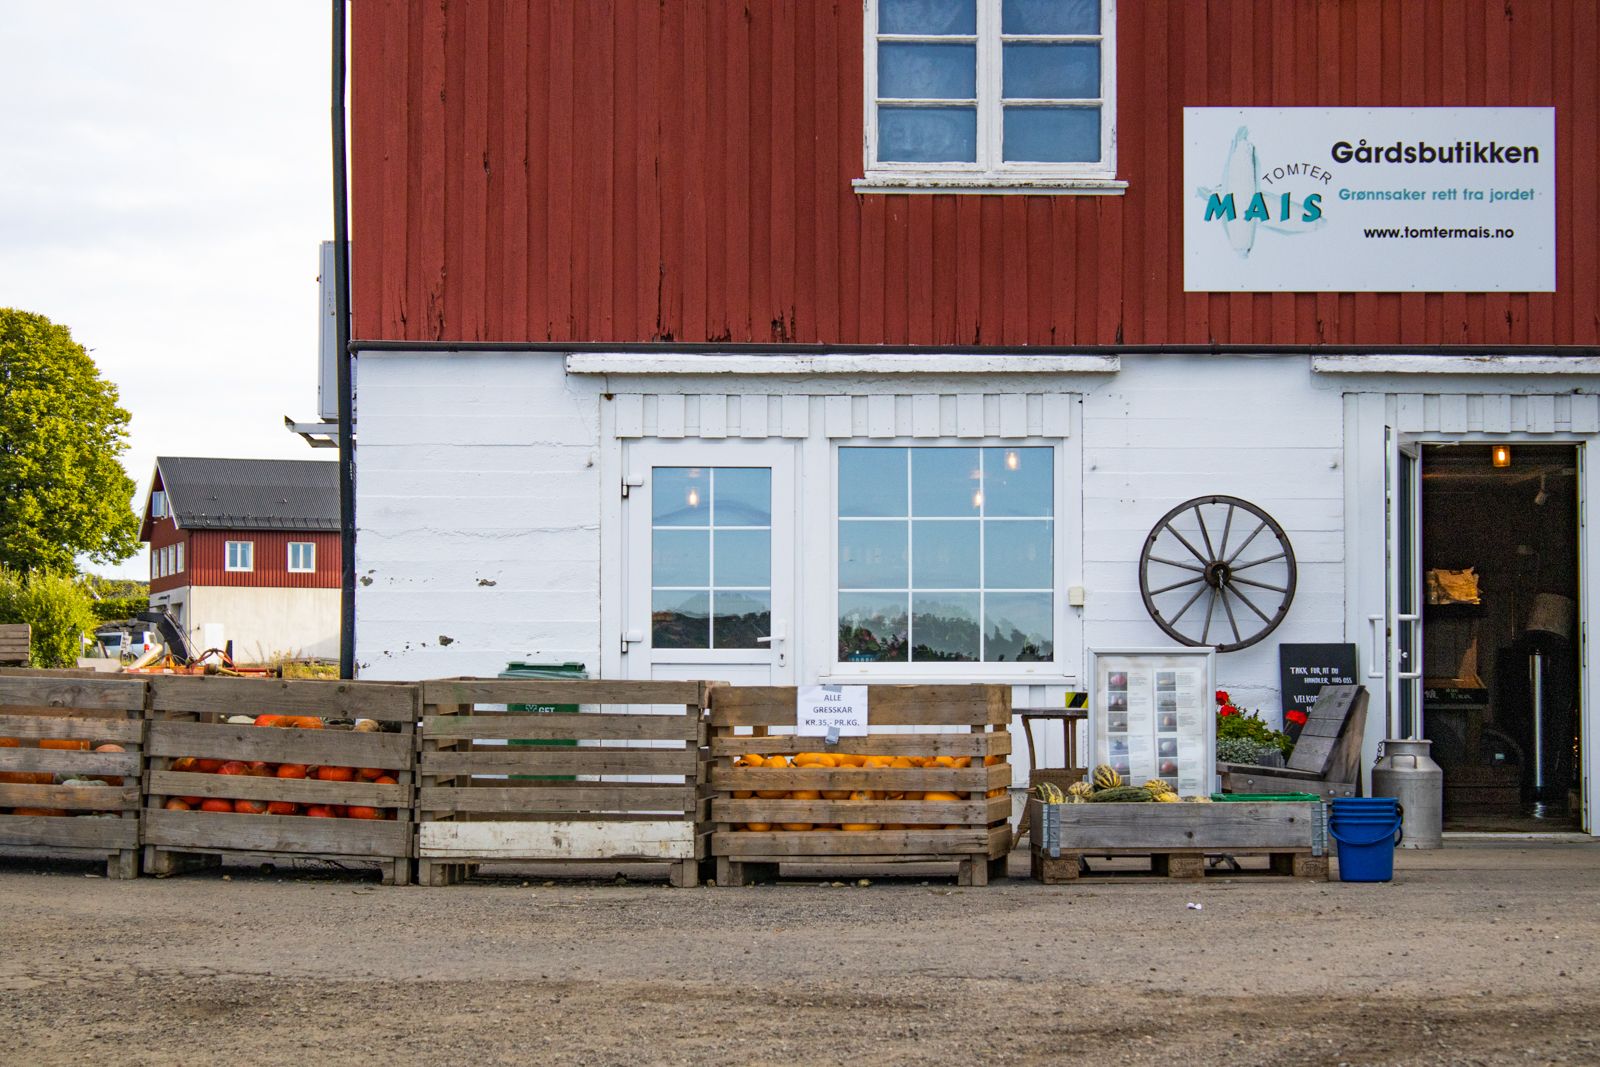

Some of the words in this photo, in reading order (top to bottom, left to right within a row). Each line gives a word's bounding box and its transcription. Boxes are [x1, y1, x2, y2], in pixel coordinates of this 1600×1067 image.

[1331, 139, 1539, 164] Gårdsbutikken
[1262, 162, 1333, 186] TOMTER
[1204, 192, 1322, 222] MAIS
[1338, 188, 1427, 201] Grønnsaker
[1432, 188, 1458, 201] rett
[1463, 188, 1485, 201] fra
[1489, 188, 1535, 203] jordet
[1363, 227, 1515, 239] www.tomtermais.no
